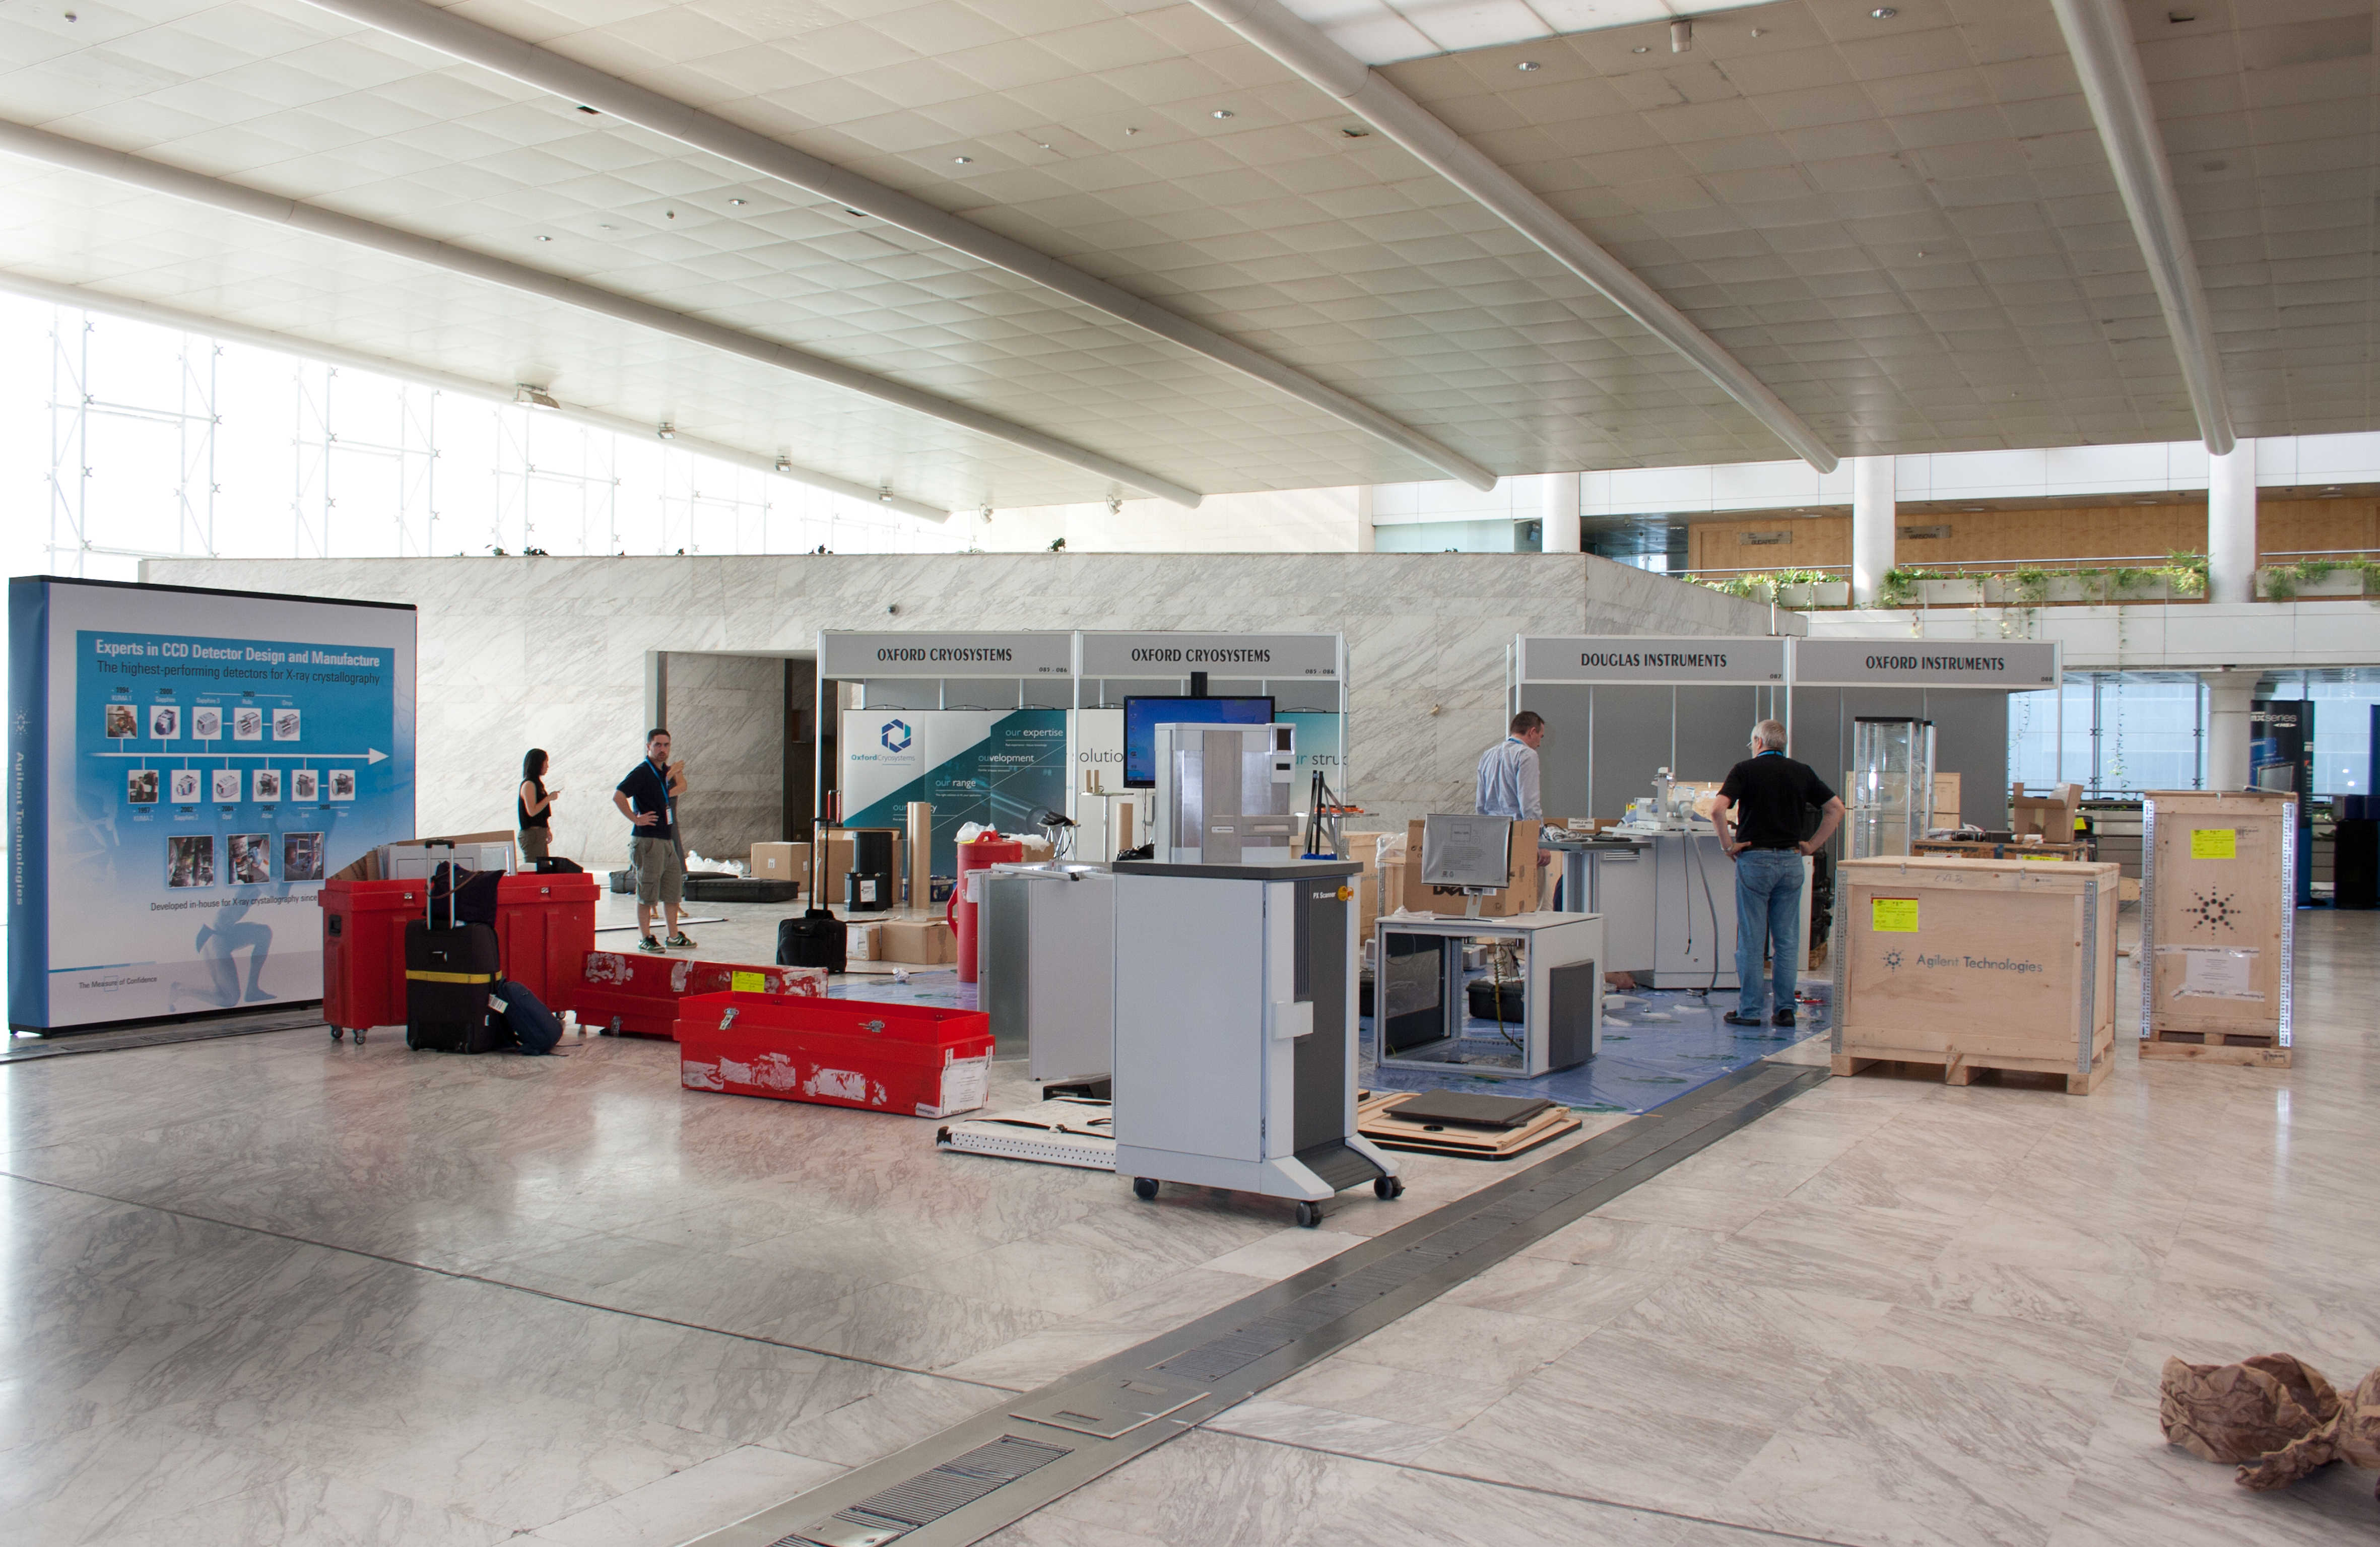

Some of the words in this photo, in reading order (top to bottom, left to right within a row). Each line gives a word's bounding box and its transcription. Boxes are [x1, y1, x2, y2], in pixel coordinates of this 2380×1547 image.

[96, 639, 144, 656] Experts
[147, 642, 158, 656] in
[162, 642, 188, 657] CCD
[192, 644, 243, 660] Detector
[246, 647, 285, 664] Design
[288, 651, 308, 663] and
[311, 651, 380, 667] Manufacture
[877, 648, 926, 661] OXFORD
[930, 648, 1012, 661] CRYOSYSTEMS
[1131, 648, 1182, 661] OXFORD
[1185, 649, 1271, 662] CRYOSYSTEMS
[1580, 653, 1640, 666] DOUGLAS
[1644, 654, 1727, 667] INSTRUMENTS
[1866, 656, 1918, 669] OXFORD
[1921, 656, 2005, 670] INSTRUMENTS
[97, 660, 118, 673] The
[121, 661, 220, 680] highest-performing
[223, 666, 268, 680] detectors
[271, 668, 284, 680] for
[286, 669, 310, 683] X-ray
[312, 671, 380, 685] crystallography
[1023, 728, 1064, 738] expertise
[1072, 748, 1123, 762] olutio
[15, 752, 24, 805] Agilent
[953, 780, 976, 789] range
[15, 809, 24, 905] Technologies
[1433, 886, 1477, 896] DEL
[151, 901, 188, 911] Developed
[189, 900, 219, 909] in-house
[232, 897, 250, 906] X-ray
[250, 895, 299, 905] crystallography
[1916, 953, 1959, 968] Agilent
[1963, 956, 2043, 973] Technologies
